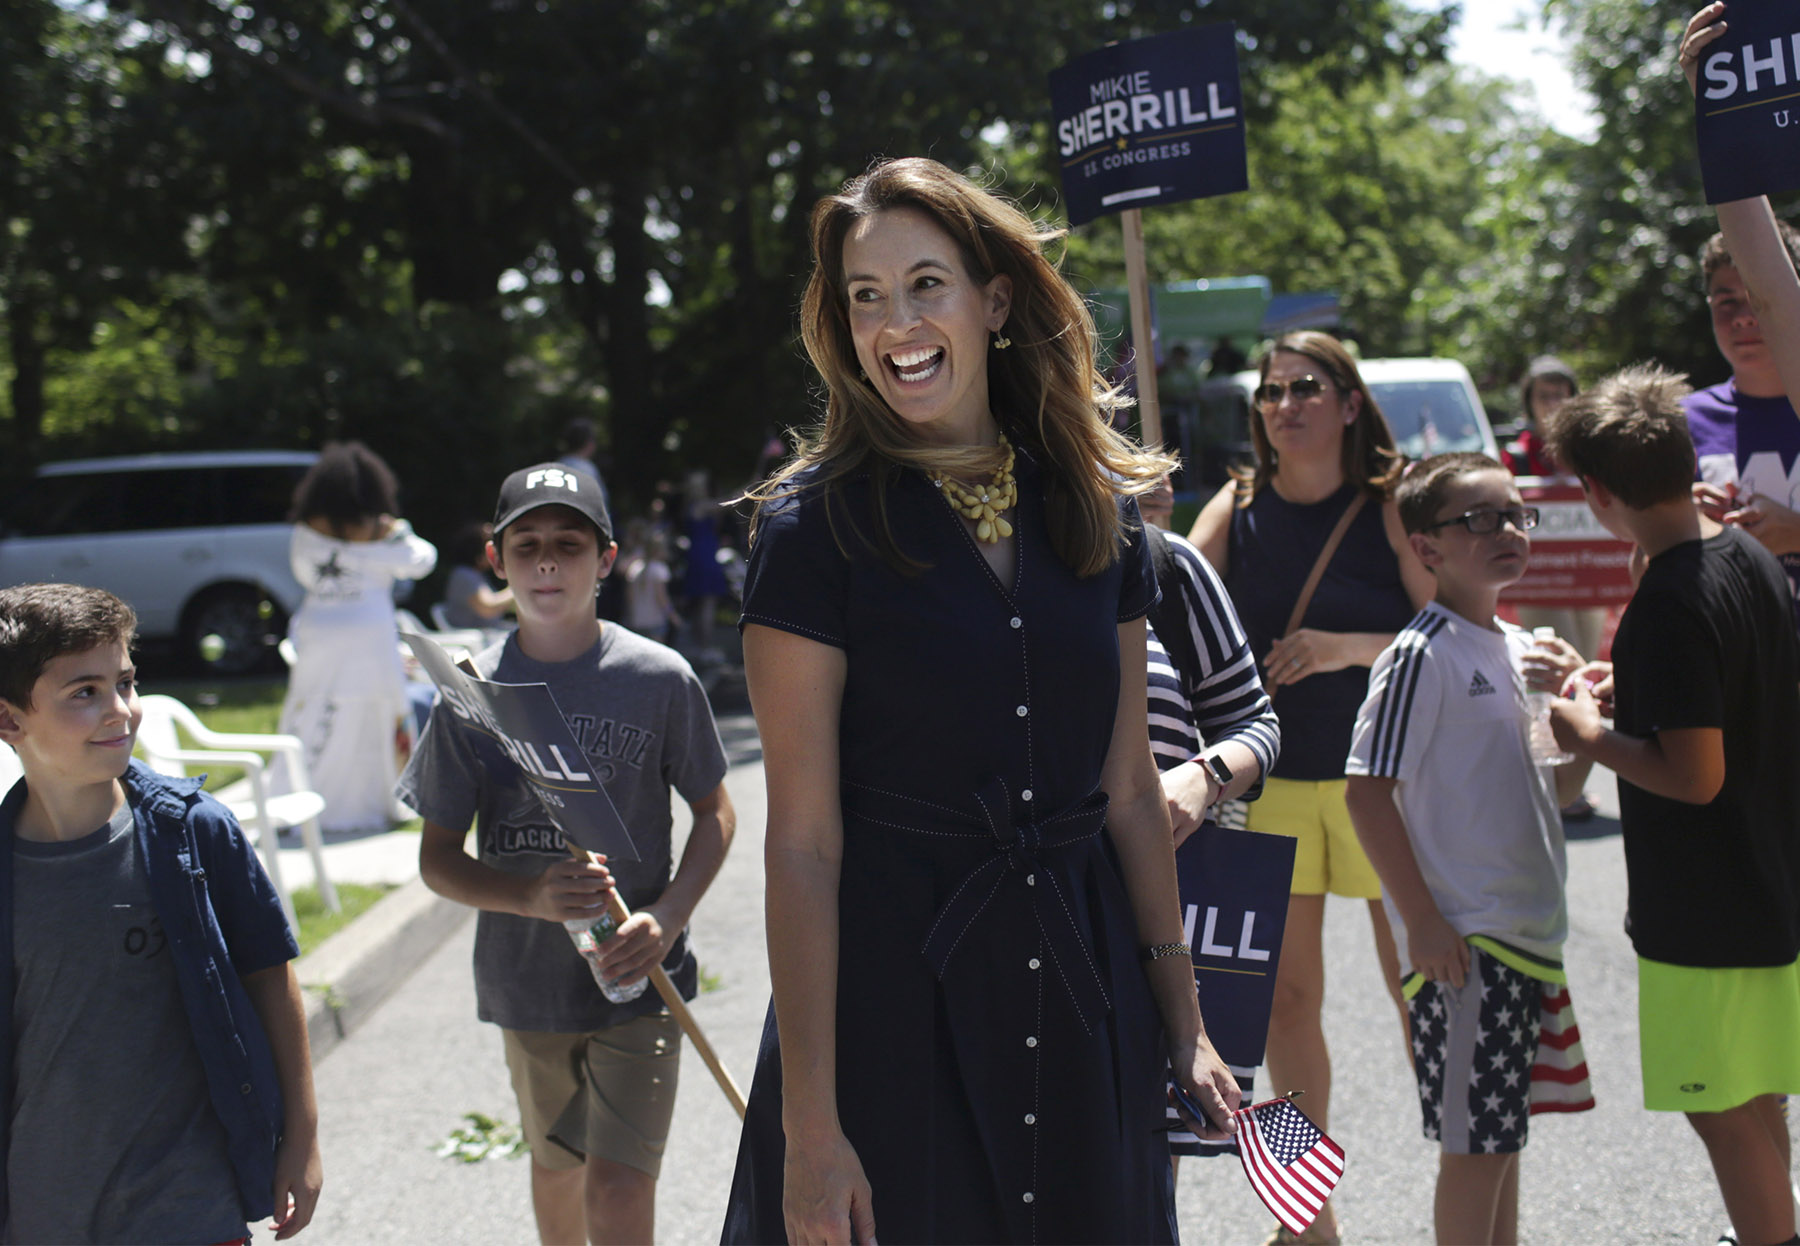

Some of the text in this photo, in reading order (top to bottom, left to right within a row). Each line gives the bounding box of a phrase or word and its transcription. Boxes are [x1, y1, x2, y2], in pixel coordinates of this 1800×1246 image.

[1090, 70, 1152, 104] MIKIE
[1058, 82, 1237, 157] SHERRILL
[1102, 141, 1192, 171] CONGRESS
[526, 468, 578, 493] FS1
